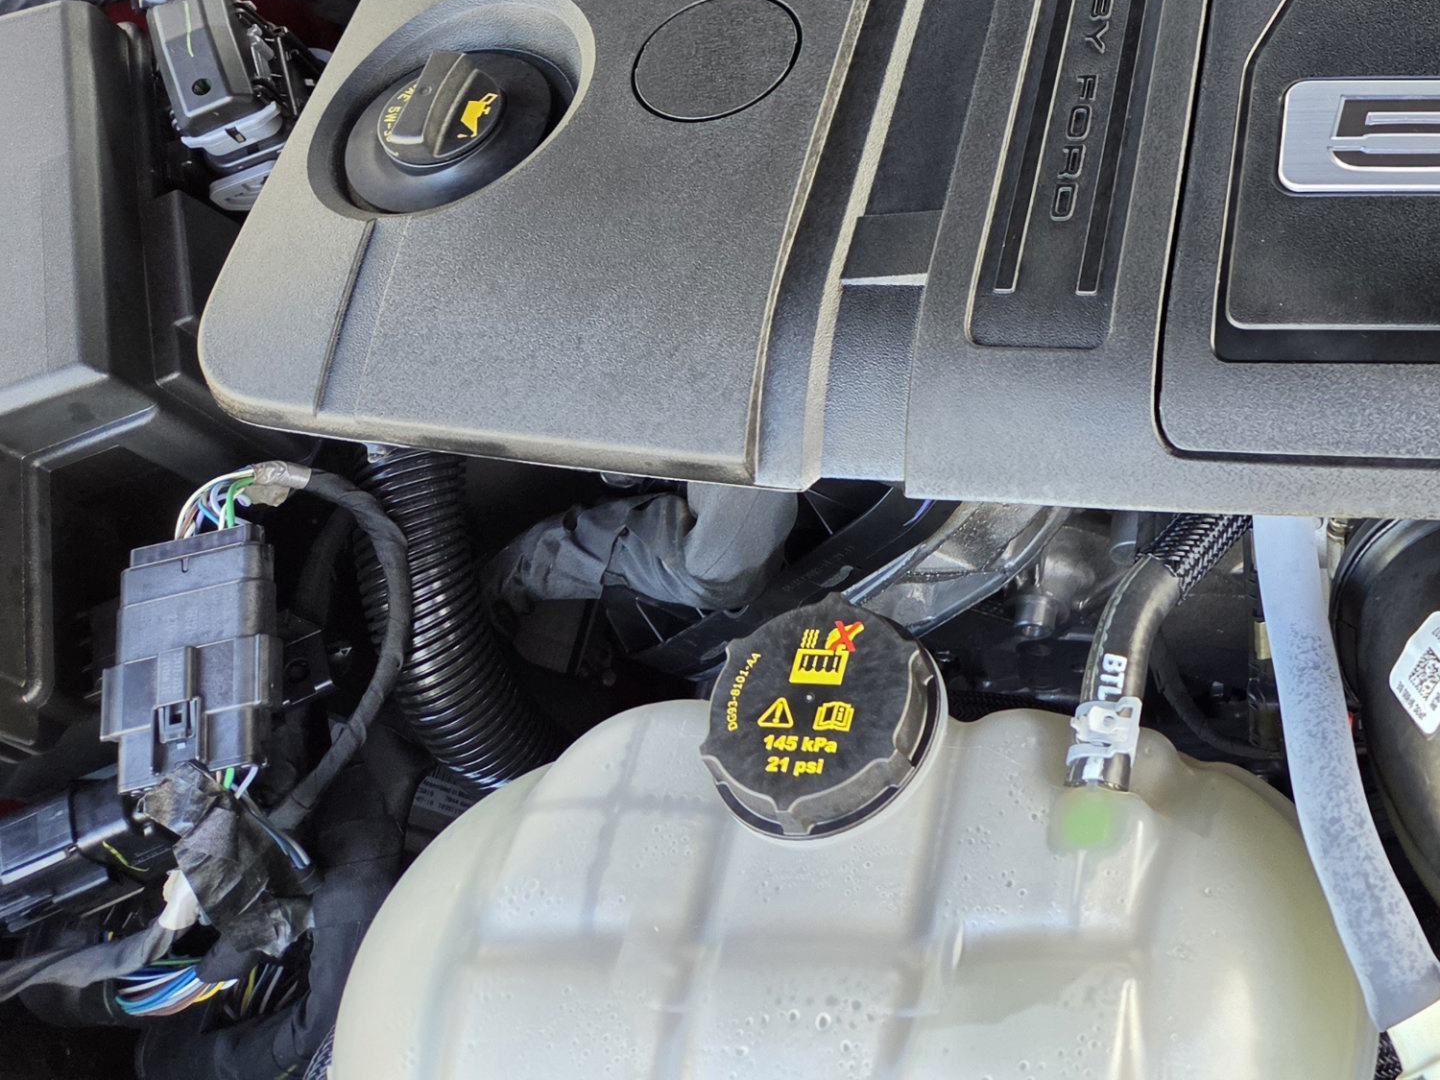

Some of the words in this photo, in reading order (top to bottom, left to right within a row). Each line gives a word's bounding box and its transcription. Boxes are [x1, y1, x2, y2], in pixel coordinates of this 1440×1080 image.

[1050, 73, 1099, 222] FORD
[728, 652, 762, 732] DG93-8101-AA
[763, 734, 798, 751] 145
[801, 736, 838, 753] kPa
[765, 756, 788, 773] 21
[793, 758, 825, 777] psi
